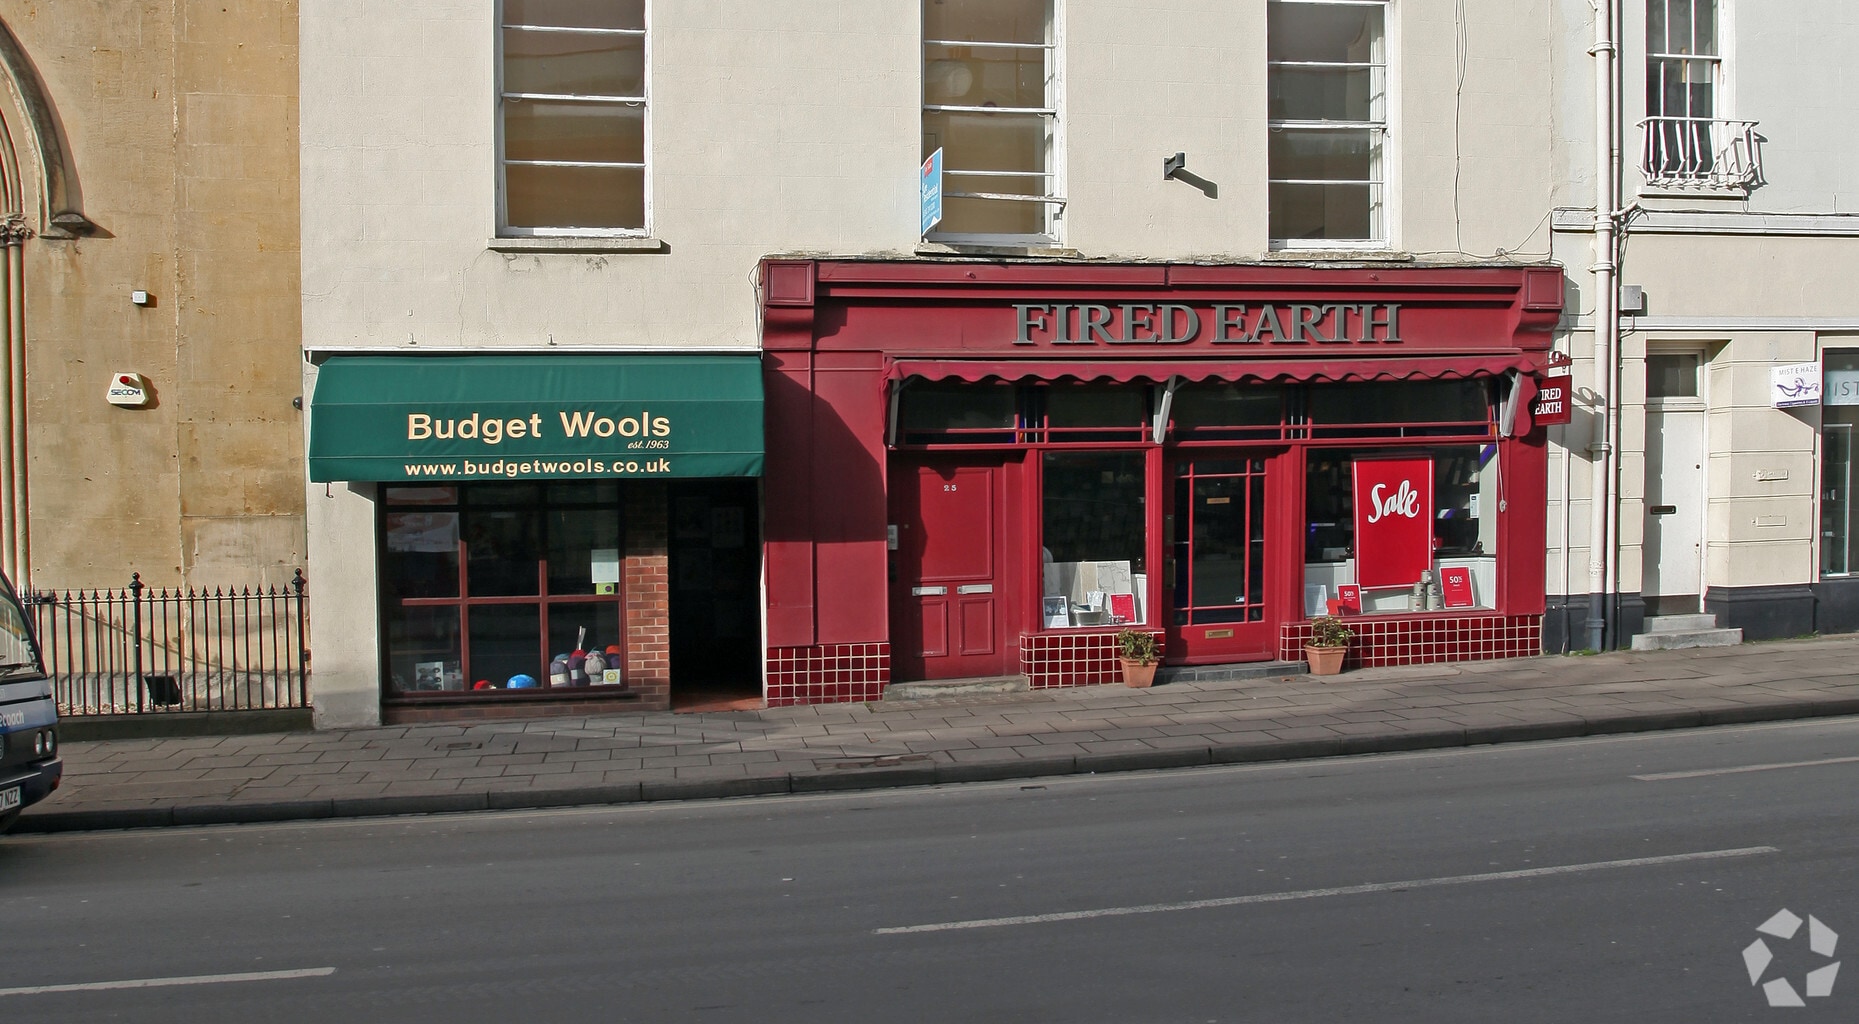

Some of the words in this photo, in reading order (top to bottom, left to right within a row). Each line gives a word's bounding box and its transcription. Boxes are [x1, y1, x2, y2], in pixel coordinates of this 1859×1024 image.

[1011, 303, 1199, 345] FIRED
[1210, 303, 1402, 344] EARTH
[111, 388, 141, 396] SECOM
[1540, 387, 1562, 401] IRED
[407, 412, 542, 445] Budget
[559, 411, 671, 438] Wools
[404, 457, 671, 478] www.budgetwools.co.uk
[1367, 479, 1420, 524] Sale
[5, 788, 18, 806] NZZ
